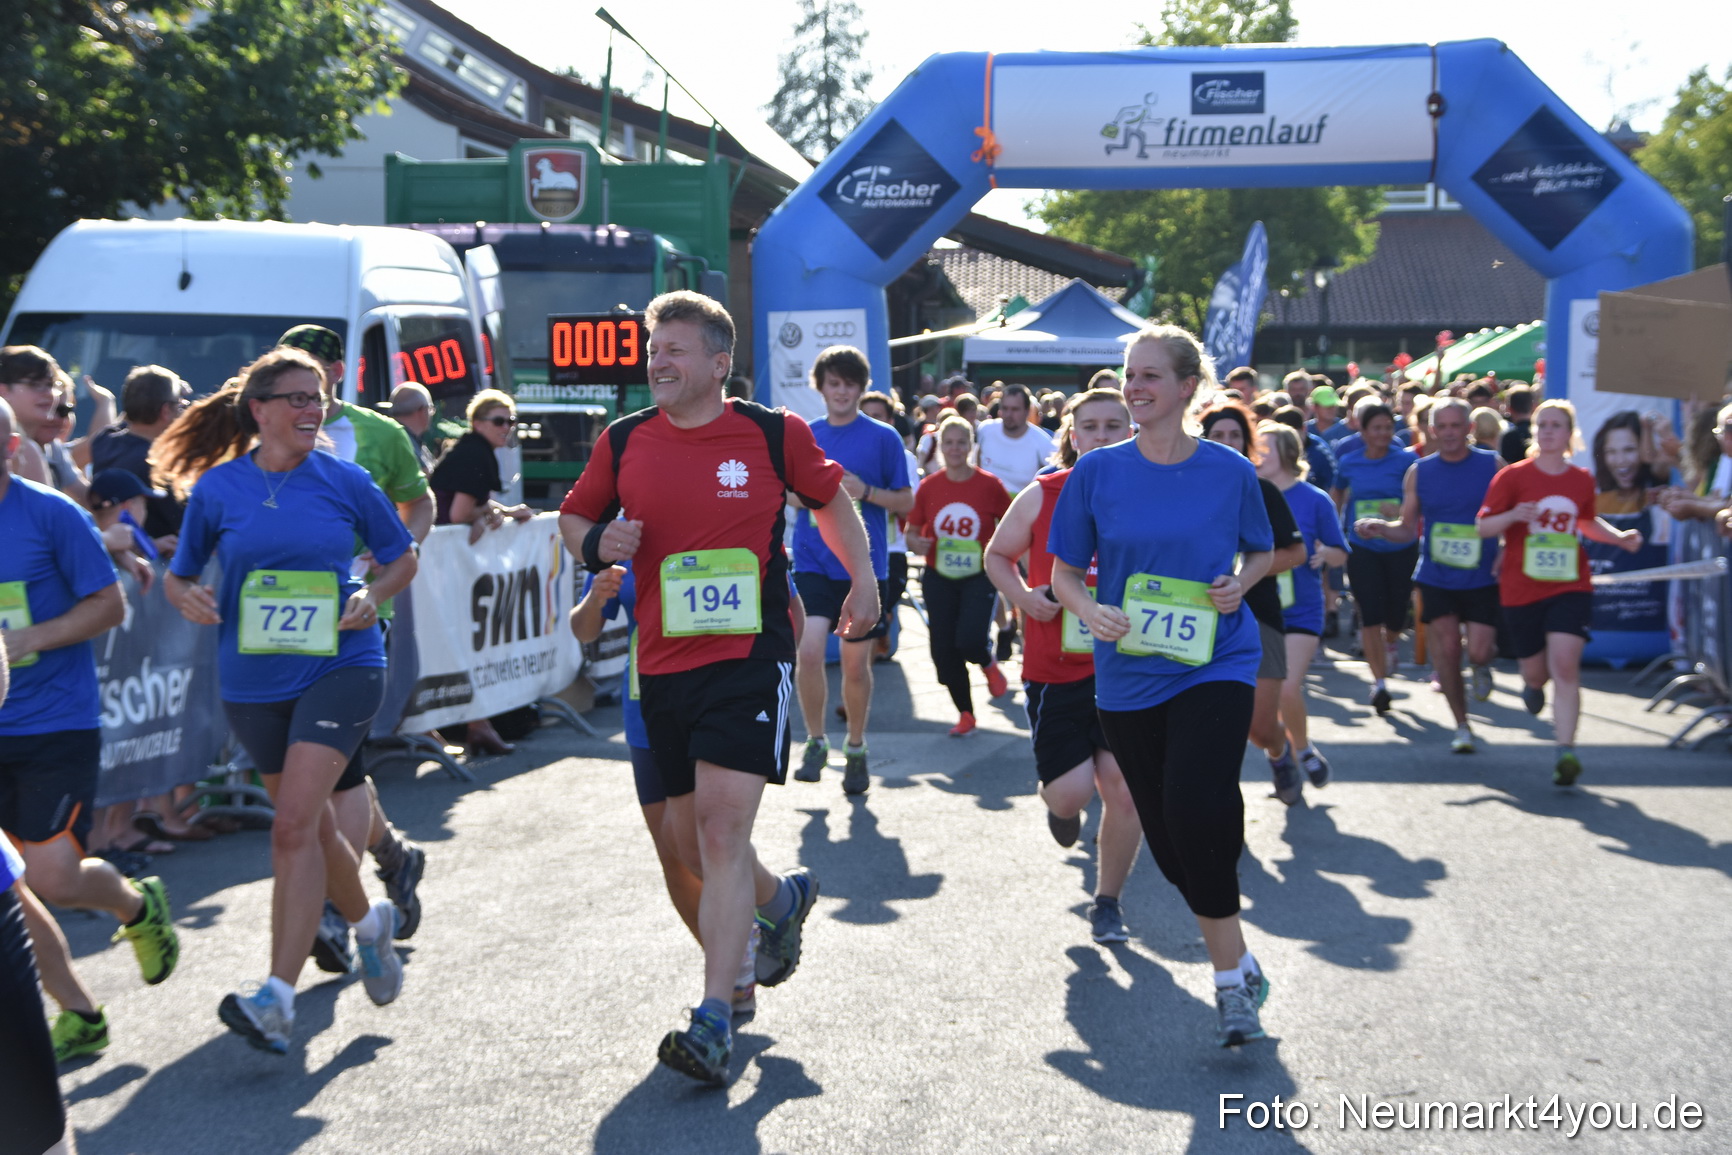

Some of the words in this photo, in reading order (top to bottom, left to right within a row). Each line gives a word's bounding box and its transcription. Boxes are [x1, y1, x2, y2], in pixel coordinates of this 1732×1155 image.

[1206, 87, 1261, 99] Fischer
[1164, 114, 1329, 146] firmenlauf
[854, 180, 941, 198] Fischer
[862, 198, 933, 208] AUTOMOBILE
[553, 320, 638, 367] 0003
[717, 489, 749, 498] caritas
[940, 514, 973, 537] 48
[1537, 509, 1570, 532] 48
[1440, 541, 1471, 556] 755
[945, 554, 971, 568] 544
[1535, 552, 1567, 567] 551
[683, 583, 741, 612] 194
[260, 605, 318, 632] 727
[1141, 608, 1197, 641] 715
